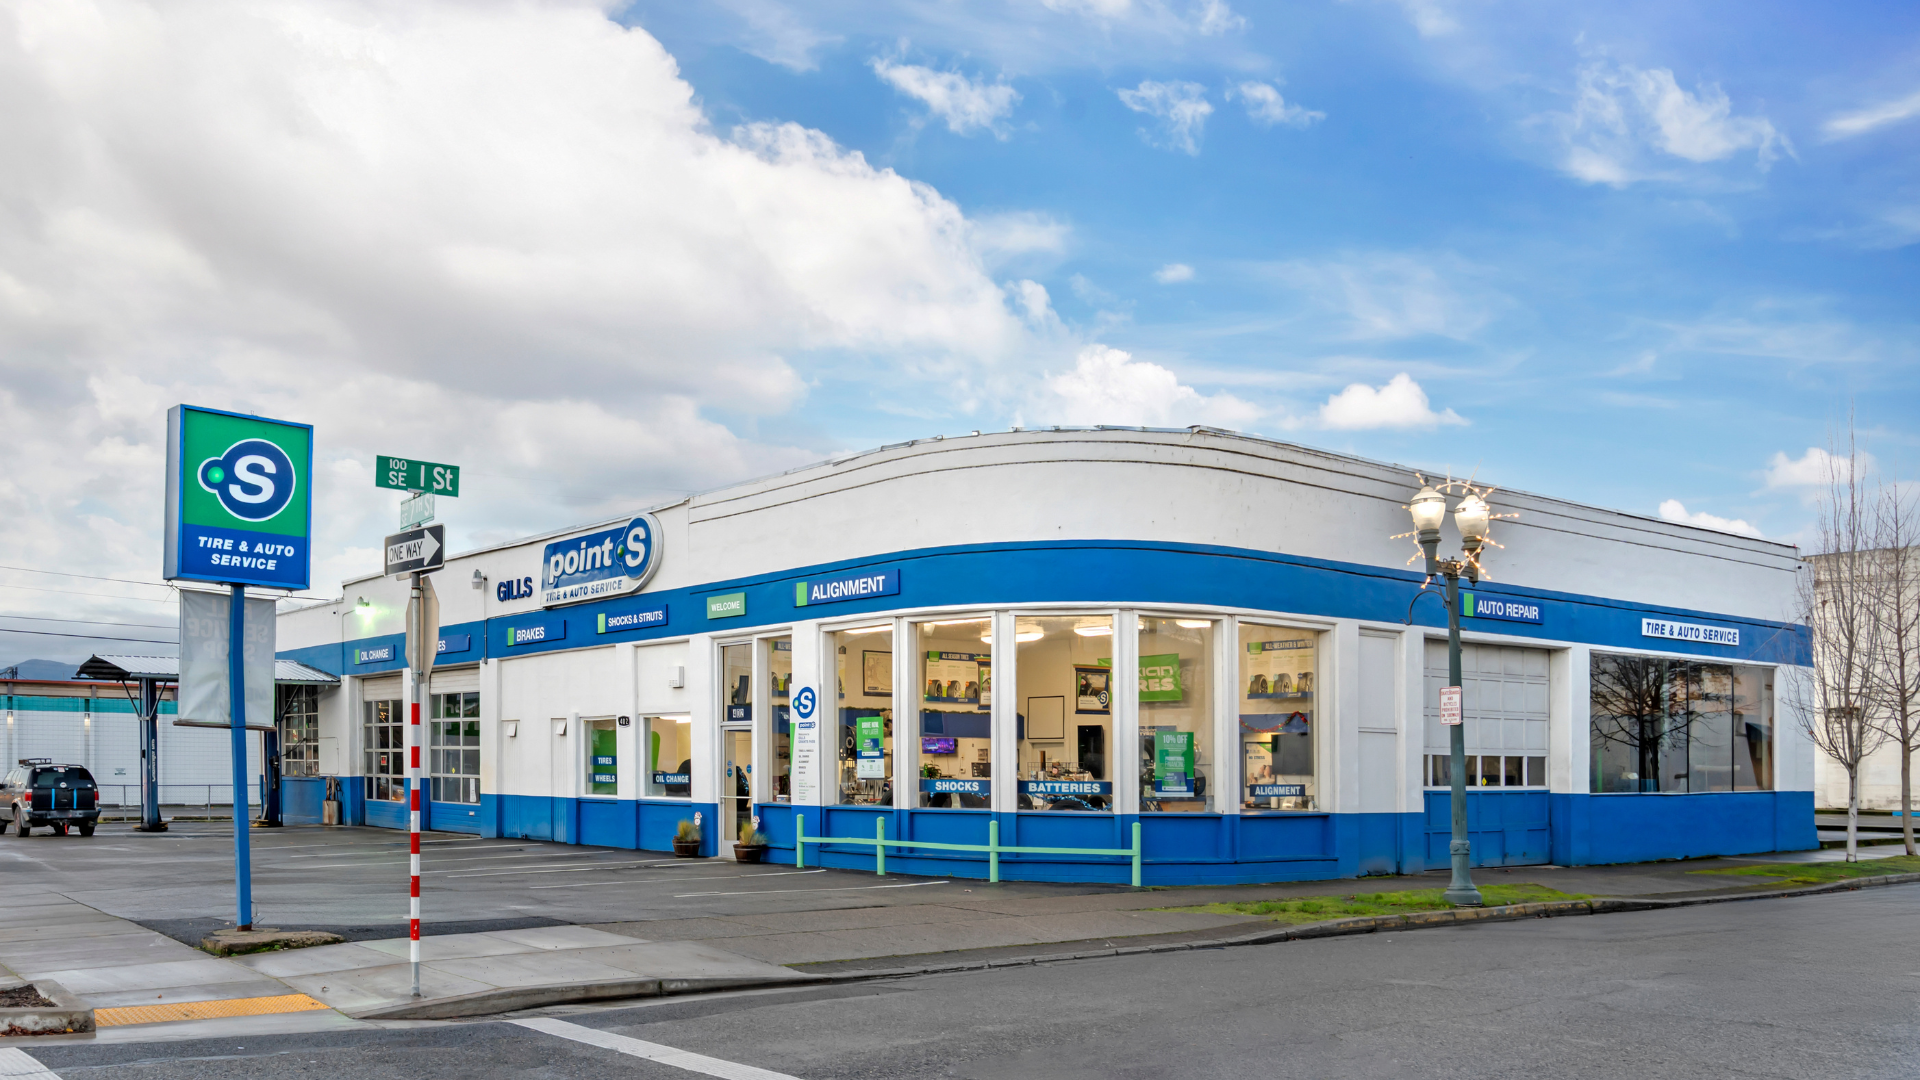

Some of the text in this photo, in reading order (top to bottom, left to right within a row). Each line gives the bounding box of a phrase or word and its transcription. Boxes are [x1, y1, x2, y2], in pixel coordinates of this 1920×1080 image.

[390, 459, 407, 470] 100
[229, 454, 276, 504] S
[388, 465, 453, 490] SE I St
[424, 493, 433, 516] St
[198, 536, 294, 557] TIRE & AUTO
[390, 541, 423, 562] ONE WAY
[549, 526, 646, 584] point S
[211, 554, 277, 570] SERVICE
[497, 576, 532, 602] GILLS
[546, 589, 560, 602] TIRE
[569, 586, 588, 597] AUTO
[590, 580, 622, 595] SERVICE
[812, 576, 886, 600] ALIGNMENT
[711, 601, 740, 612] WELCOME
[1477, 600, 1539, 619] AUTO REPAIR
[608, 610, 663, 627] SHOCKS & STRUTS
[516, 627, 544, 642] BRAKES
[1646, 622, 1737, 643] TIRE & AUTO SERVICE
[369, 648, 388, 660] CHANGE
[799, 692, 813, 713] S
[1163, 734, 1188, 744] 10% OFF
[935, 782, 979, 791] SHOCKS
[1029, 782, 1100, 793] BATTERIES
[1255, 786, 1300, 795] ALIGNMENT
